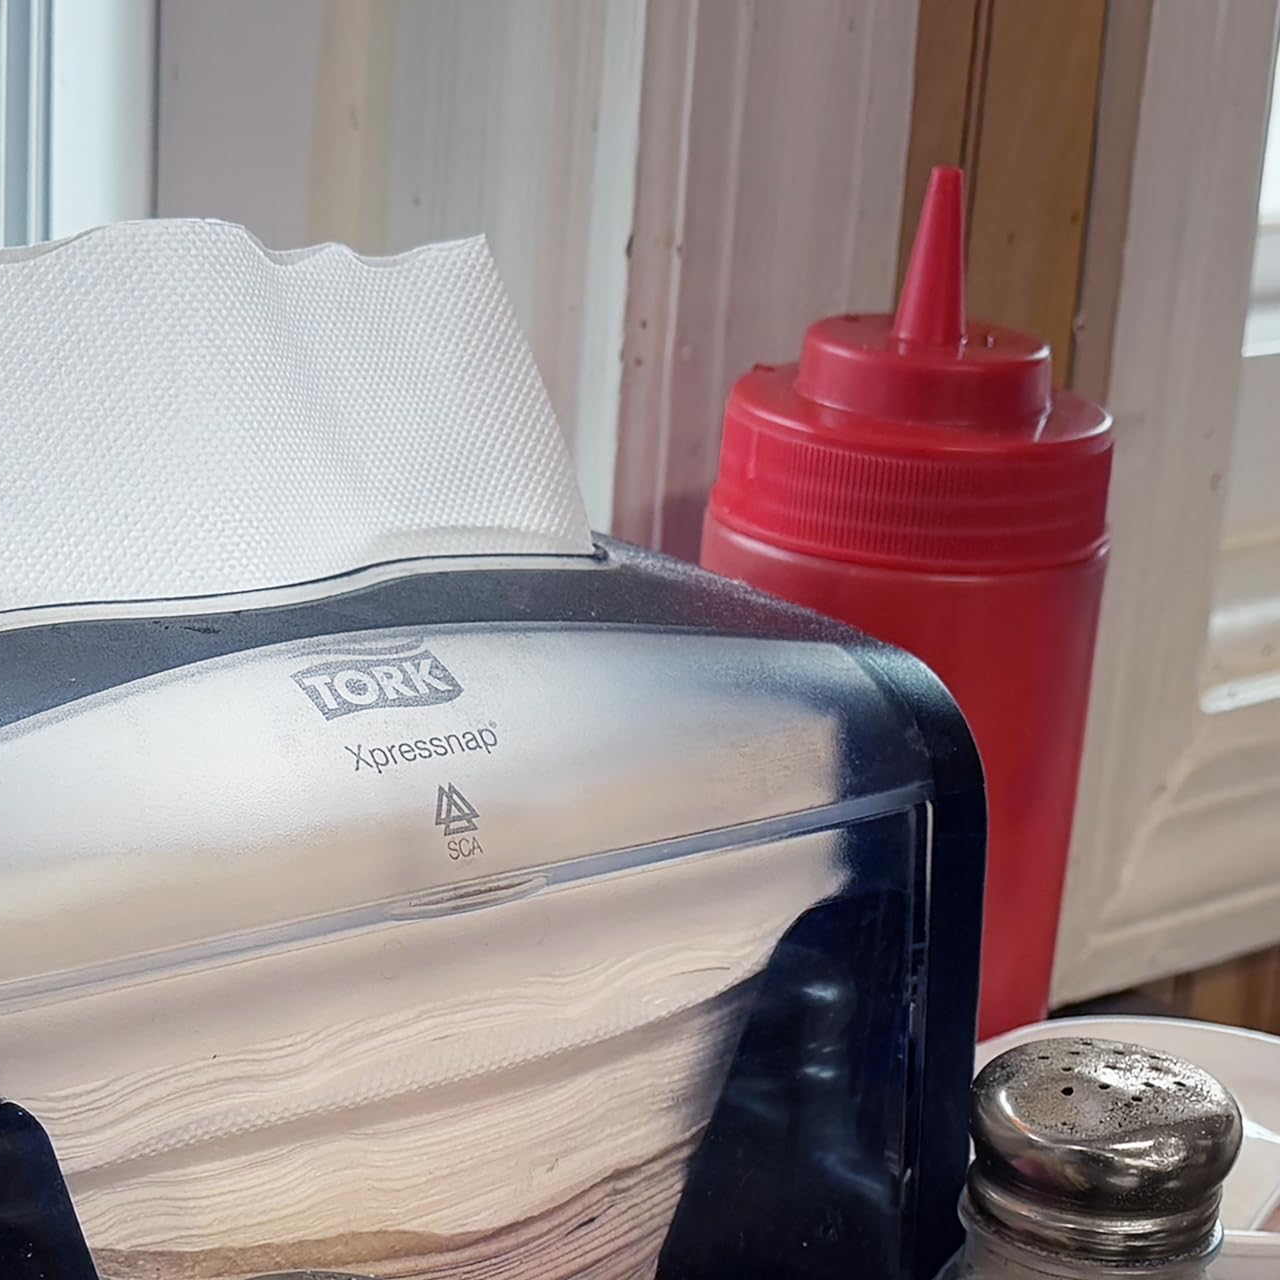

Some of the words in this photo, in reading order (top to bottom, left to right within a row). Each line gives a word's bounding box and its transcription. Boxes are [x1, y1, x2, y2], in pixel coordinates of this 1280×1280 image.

[302, 658, 454, 711] TORK
[344, 724, 498, 774] Xpressnap
[447, 836, 483, 861] SCA
